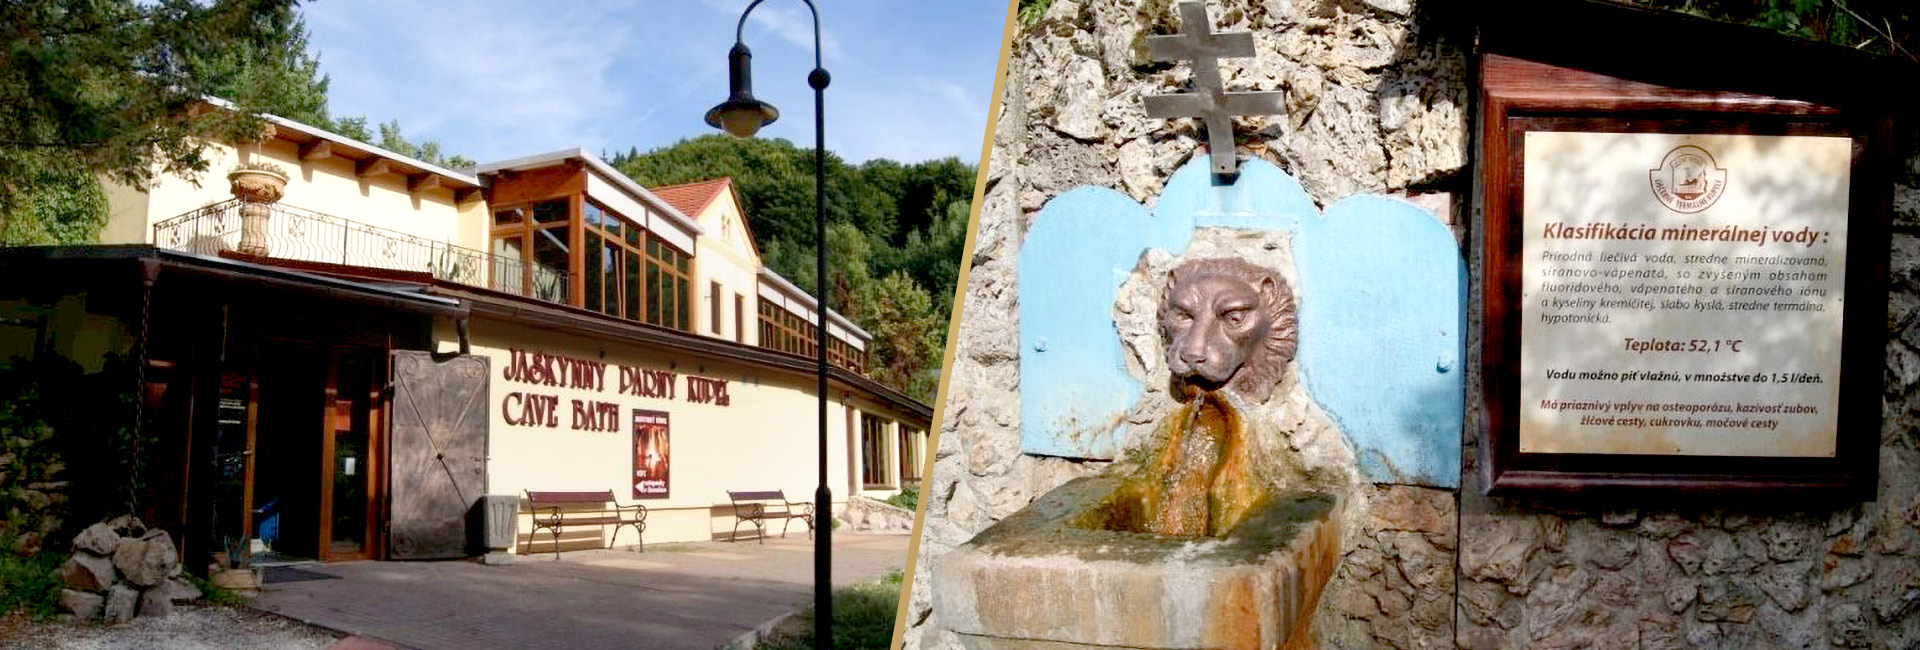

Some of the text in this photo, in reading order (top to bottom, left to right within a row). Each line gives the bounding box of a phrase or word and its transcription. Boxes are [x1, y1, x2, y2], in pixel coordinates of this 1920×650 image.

[1543, 222, 1656, 240] Klasifikácia
[1661, 224, 1767, 247] minerálnej
[1772, 226, 1819, 248] vody
[1645, 252, 1677, 265] voda,
[1684, 253, 1728, 264] stredne
[1676, 271, 1690, 279] so
[1769, 270, 1827, 281] obsahom
[1710, 286, 1718, 294] a
[1541, 299, 1549, 308] a
[1552, 297, 1596, 311] kyseliny
[1660, 300, 1690, 309] slabo
[1728, 301, 1770, 311] stredne
[1625, 338, 1685, 354] Teplota:
[1688, 340, 1721, 354] 52,1
[1546, 369, 1576, 380] Vodu
[1579, 370, 1619, 381] možno
[1640, 371, 1681, 382] vlažnú,
[1685, 374, 1692, 382] v
[1694, 372, 1750, 383] množstve
[1753, 373, 1768, 383] do
[1772, 373, 1788, 384] 1,5
[502, 391, 620, 433] CAVE BATH
[1560, 400, 1612, 413] priaznivý
[1614, 401, 1643, 413] vplyv
[1784, 404, 1818, 415] zubov,
[1617, 417, 1646, 429] cesty,
[1649, 417, 1703, 429] cukrovku,
[1706, 418, 1749, 429] močové
[1751, 420, 1778, 431] cesty
